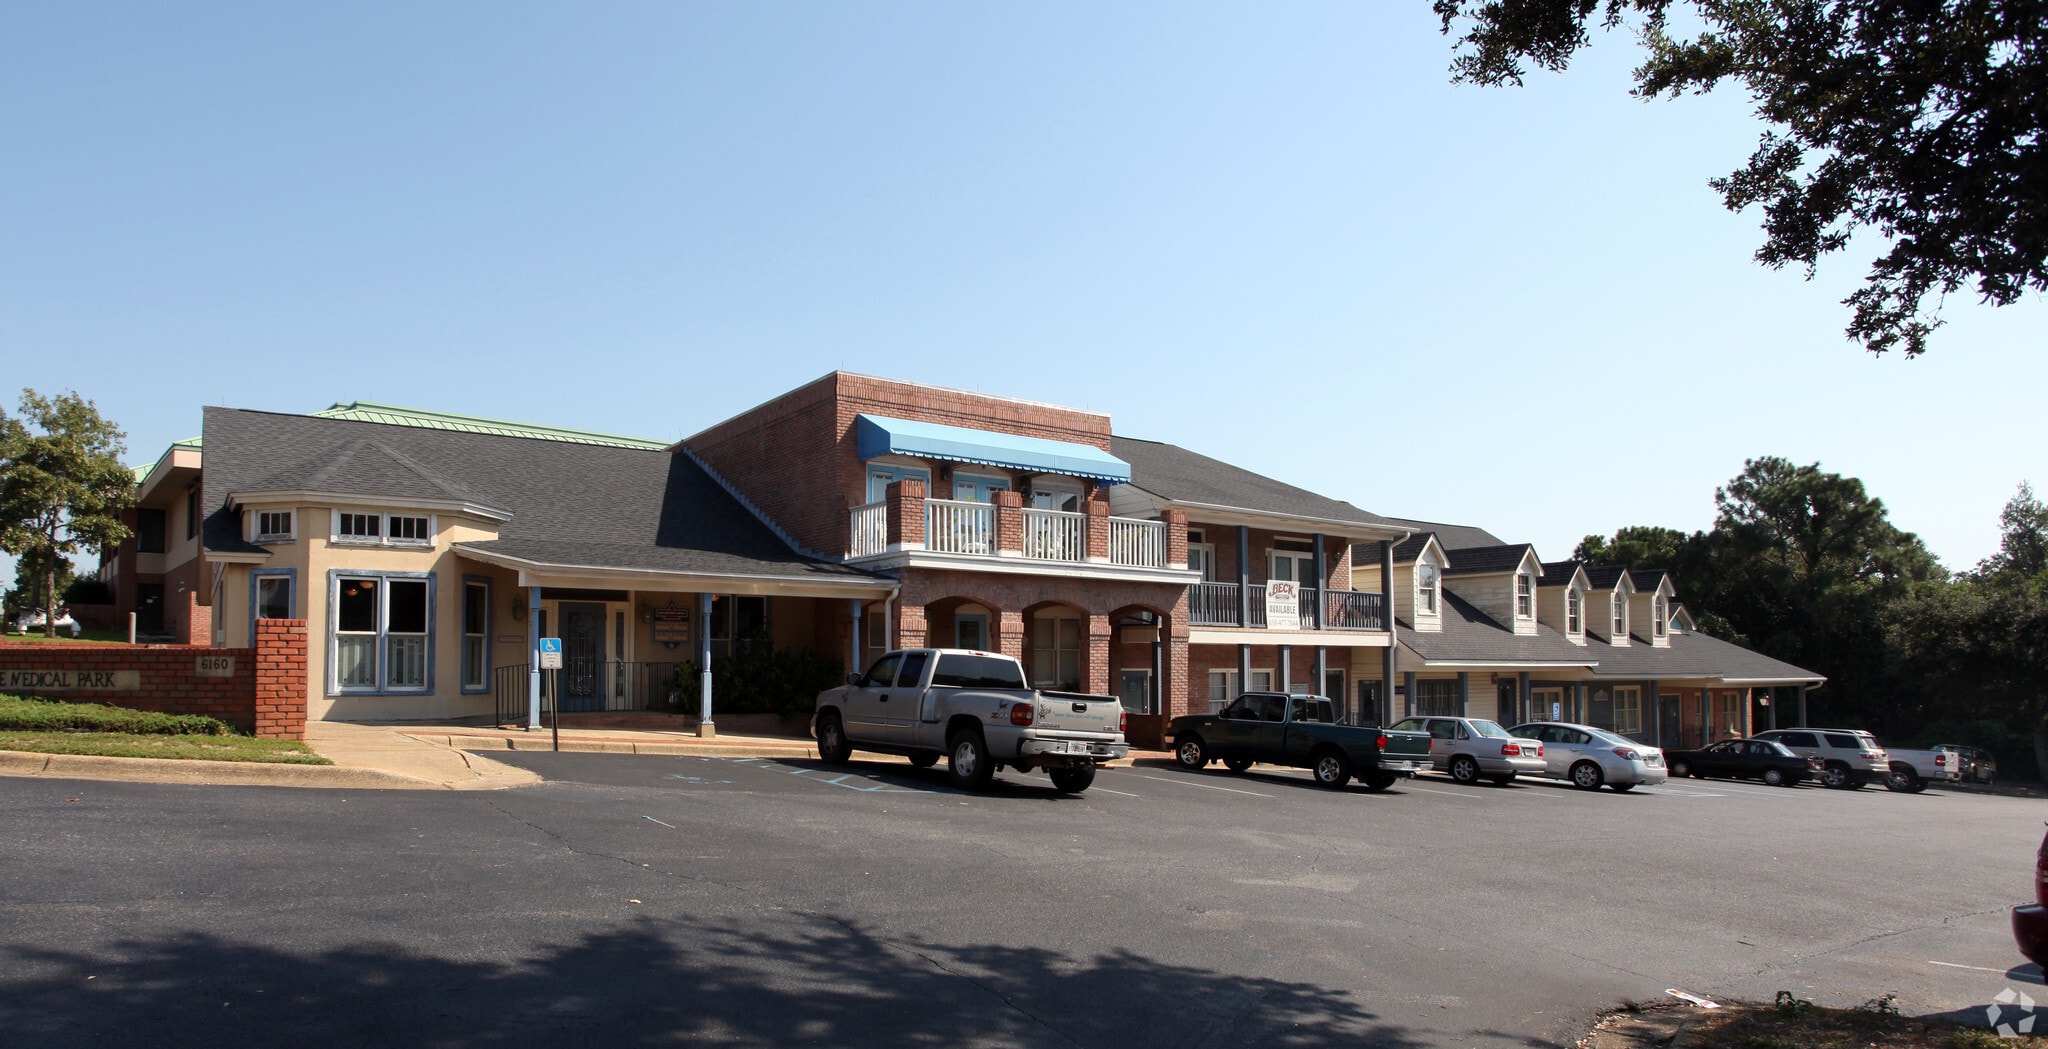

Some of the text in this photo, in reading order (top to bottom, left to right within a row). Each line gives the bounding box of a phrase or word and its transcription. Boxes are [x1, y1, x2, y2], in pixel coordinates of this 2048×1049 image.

[1269, 583, 1296, 598] BECK
[1269, 605, 1296, 615] AVAILABLE
[201, 659, 228, 670] 6160
[10, 672, 71, 687] MEDICAL
[77, 672, 116, 687] PARK
